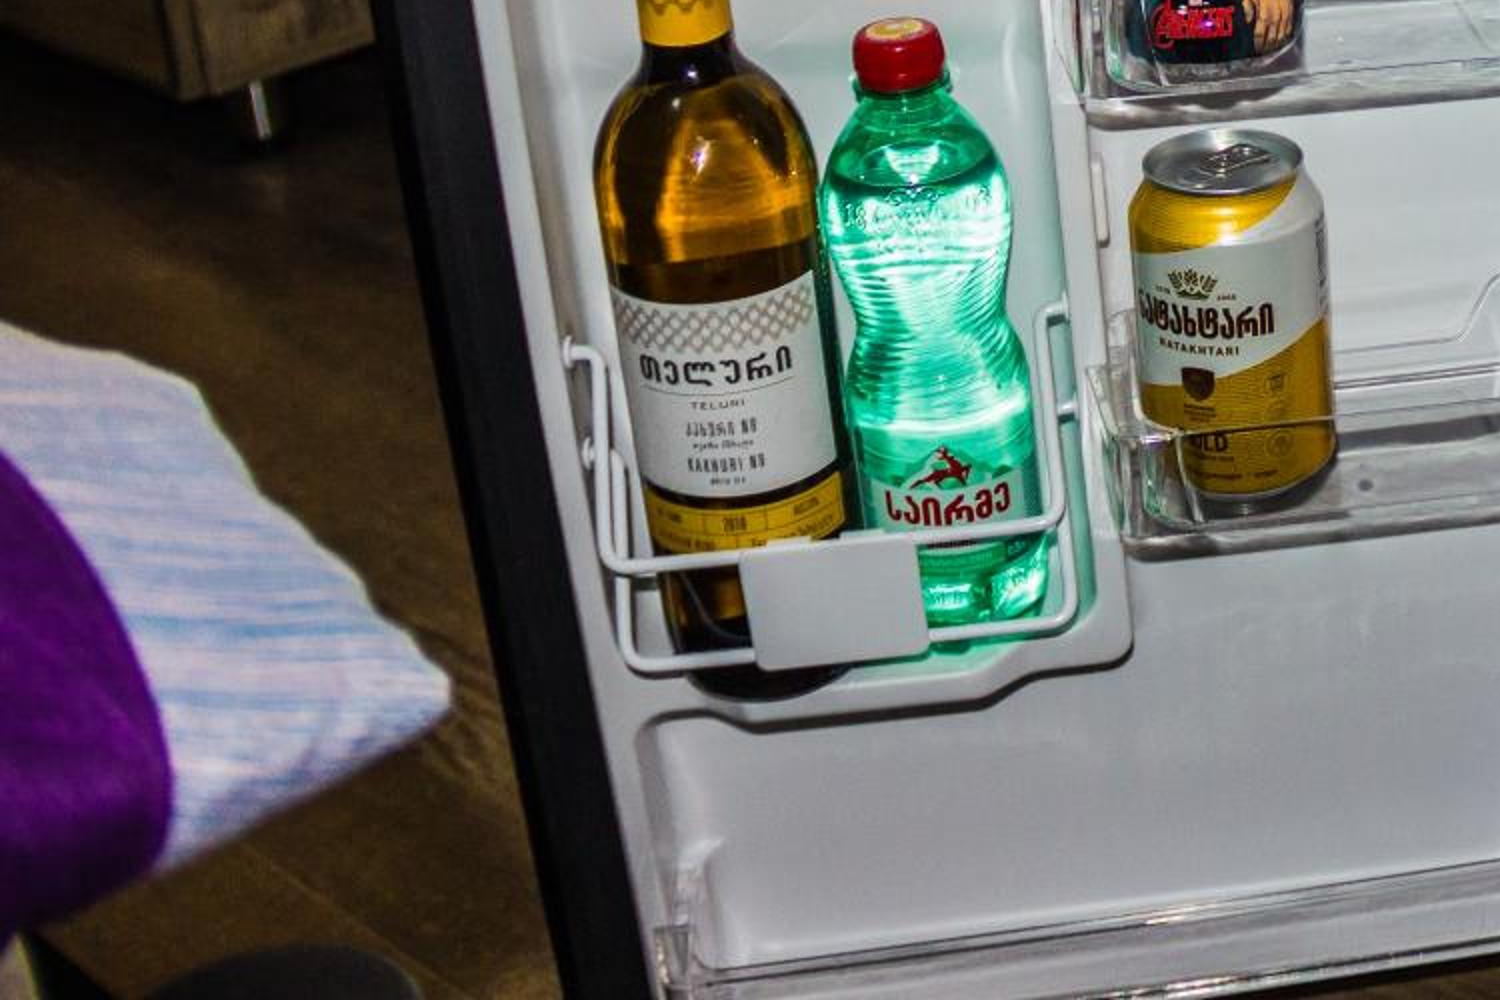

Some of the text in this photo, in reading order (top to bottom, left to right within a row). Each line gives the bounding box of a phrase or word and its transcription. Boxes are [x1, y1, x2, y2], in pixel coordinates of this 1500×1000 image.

[639, 345, 793, 387] თელური
[1160, 338, 1240, 356] NATAKHTARI
[884, 481, 1011, 526] საირმე
